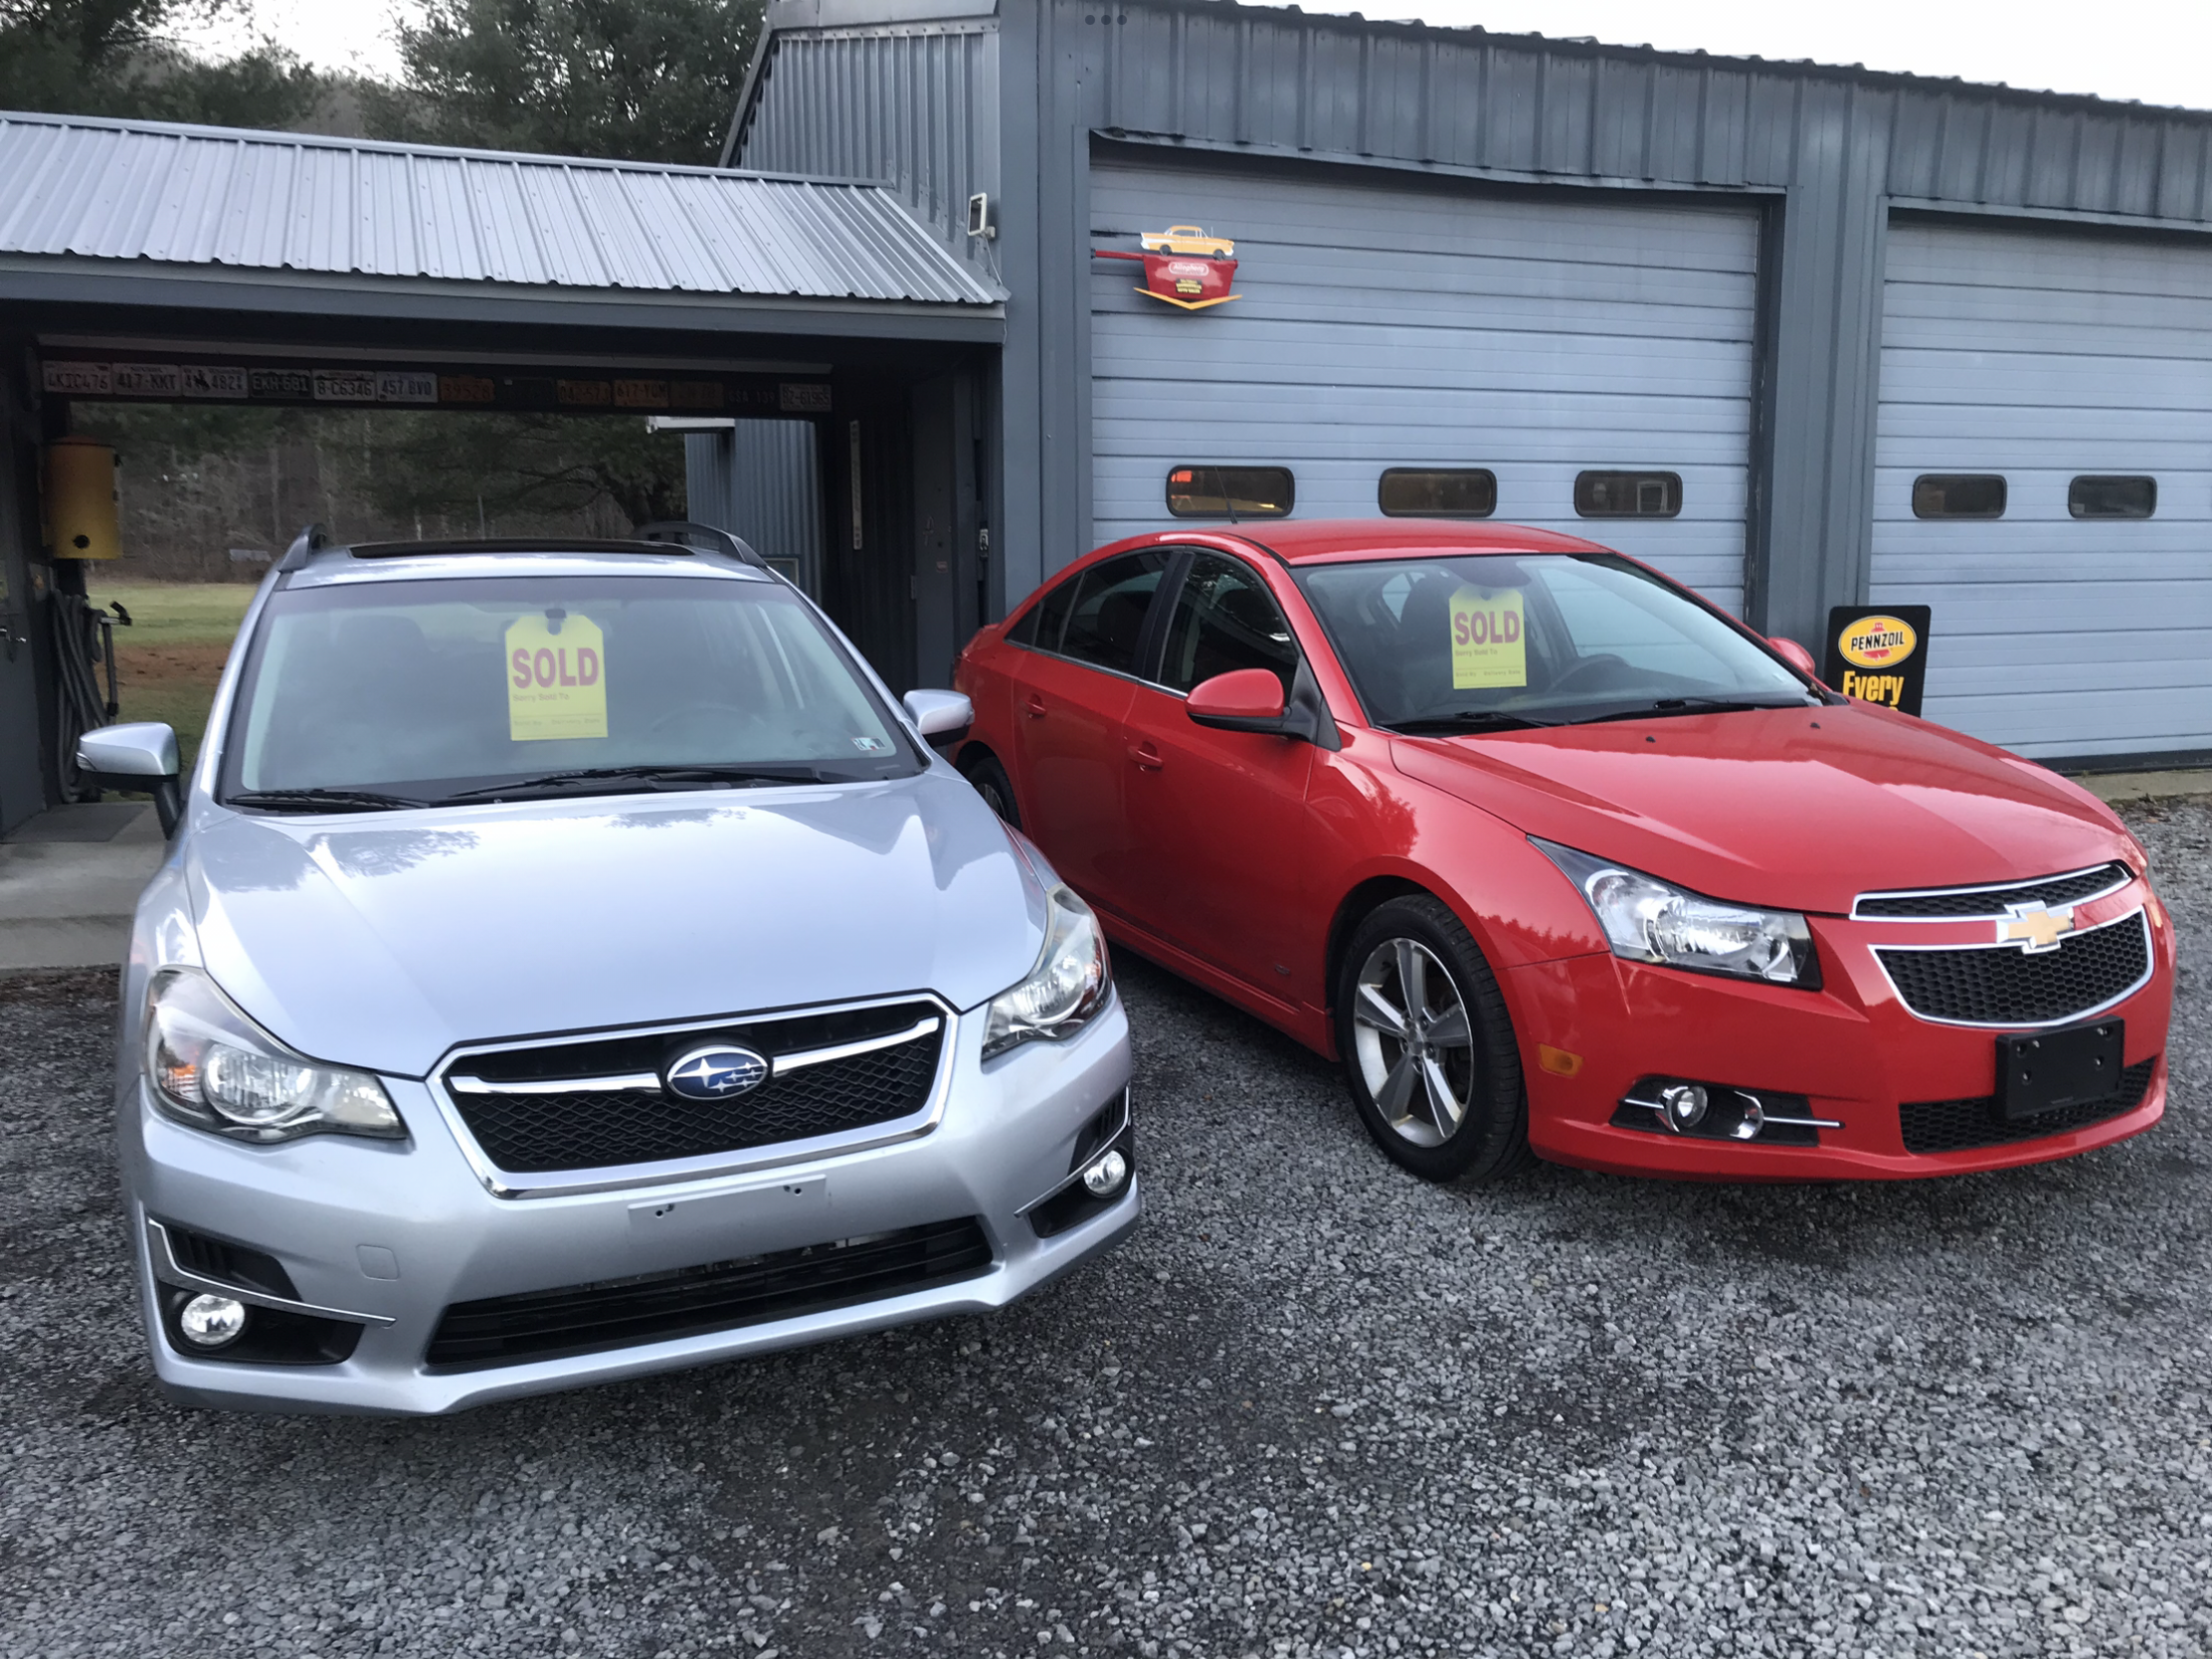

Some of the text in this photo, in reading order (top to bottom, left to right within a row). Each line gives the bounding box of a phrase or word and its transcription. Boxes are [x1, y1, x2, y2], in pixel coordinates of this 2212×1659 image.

[1454, 611, 1521, 646] SOLD
[1850, 631, 1905, 651] PENNZOIL
[512, 647, 600, 689] SOLD
[512, 693, 536, 703] Sorry
[1842, 669, 1905, 706] Every
